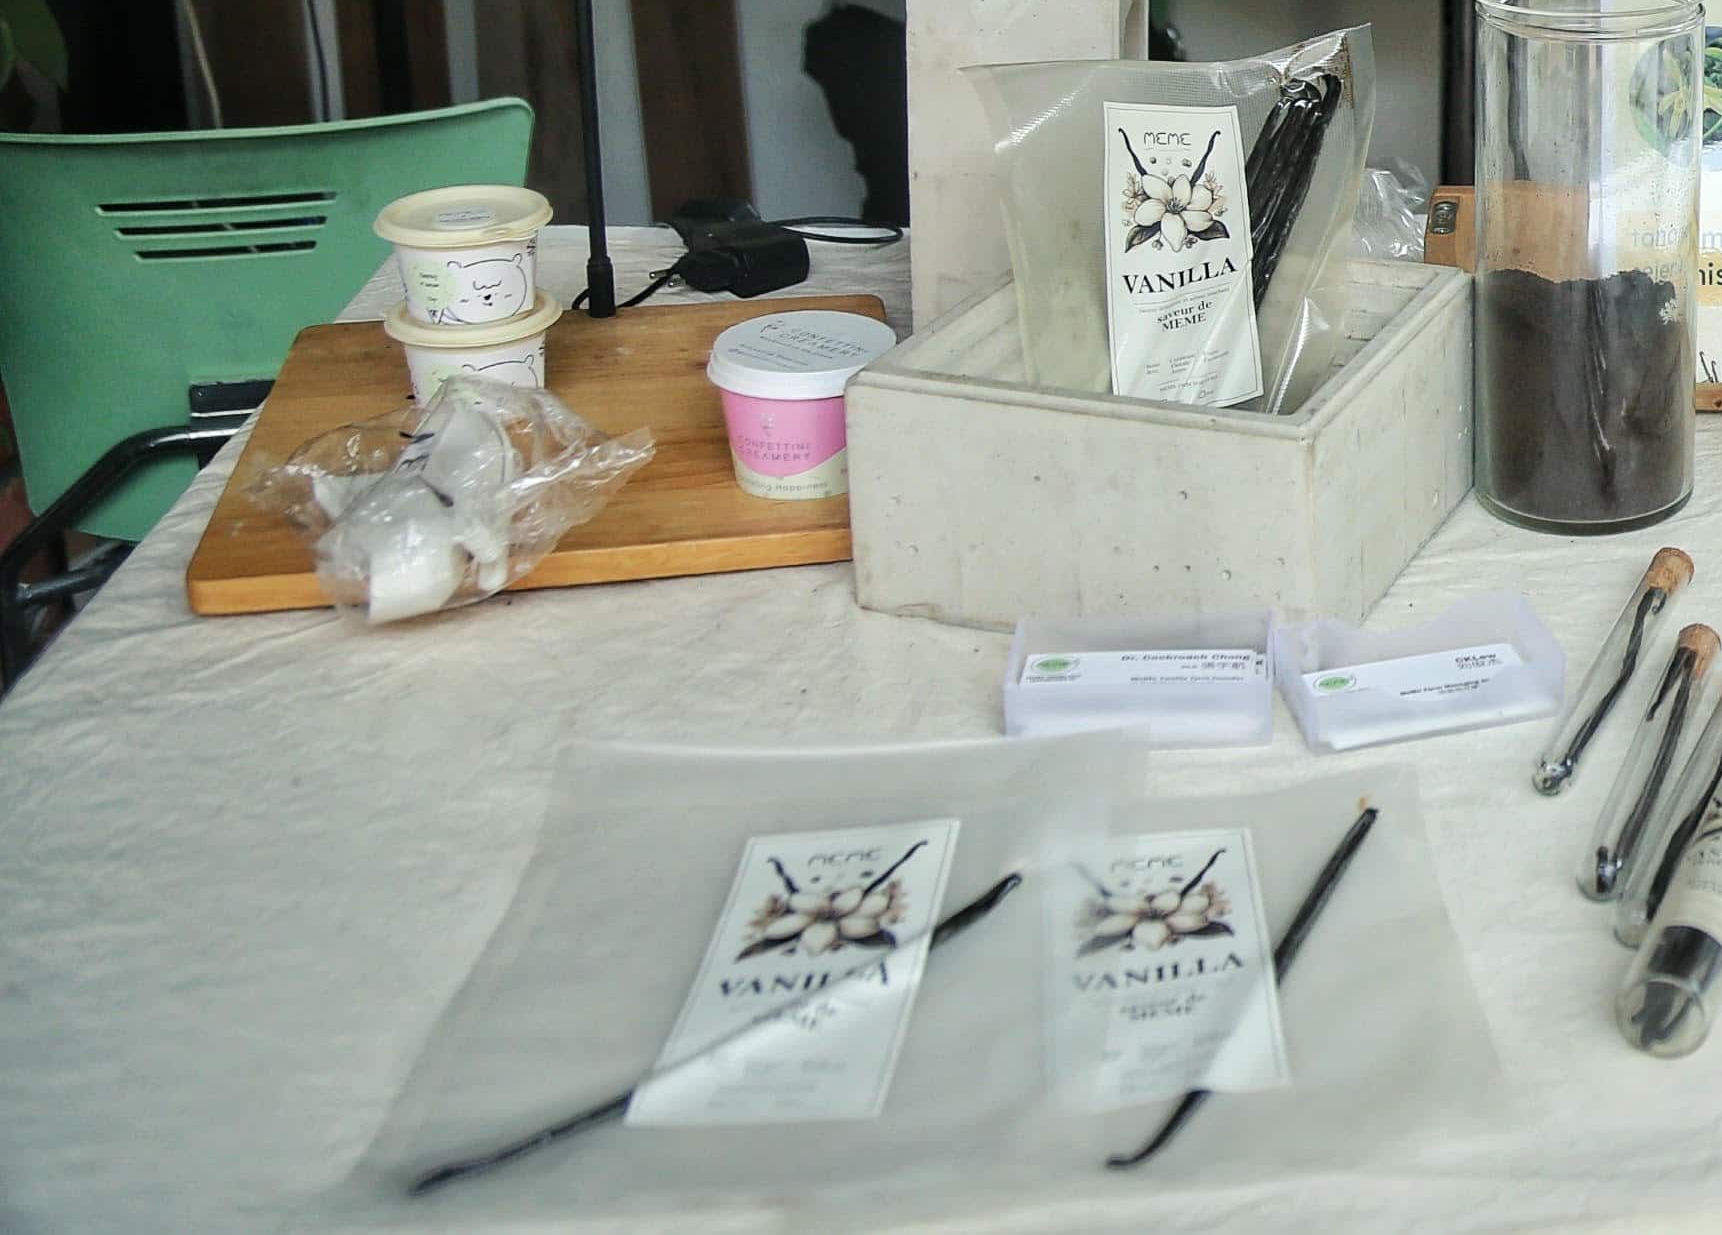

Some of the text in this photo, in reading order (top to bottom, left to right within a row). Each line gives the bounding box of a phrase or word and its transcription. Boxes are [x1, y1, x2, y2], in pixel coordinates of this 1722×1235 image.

[1122, 256, 1238, 294] VANILLA
[1157, 305, 1194, 323] saveur
[1198, 300, 1213, 311] de
[1162, 312, 1206, 331] MEME
[721, 961, 889, 998] VANILA
[1073, 952, 1245, 991] VANILLA
